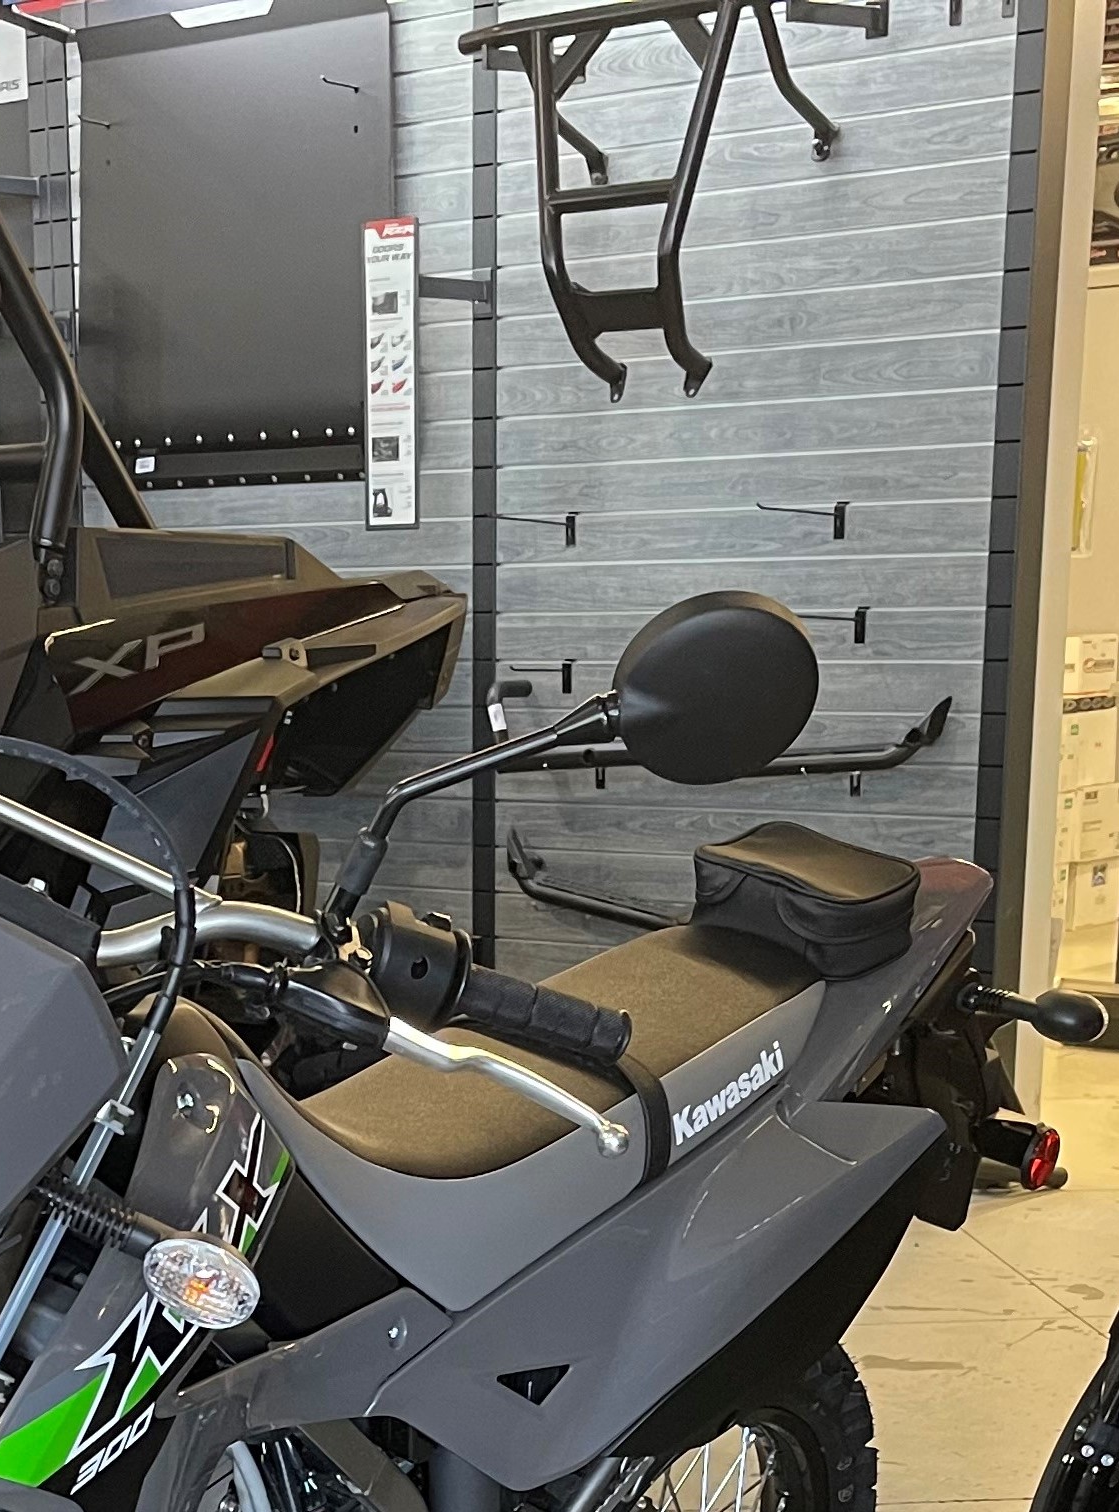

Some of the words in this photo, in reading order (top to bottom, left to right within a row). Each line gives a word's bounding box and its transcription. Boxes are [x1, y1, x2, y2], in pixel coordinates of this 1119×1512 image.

[68, 621, 206, 696] XP
[672, 1040, 784, 1146] Kawasaki
[70, 1401, 157, 1496] 300
